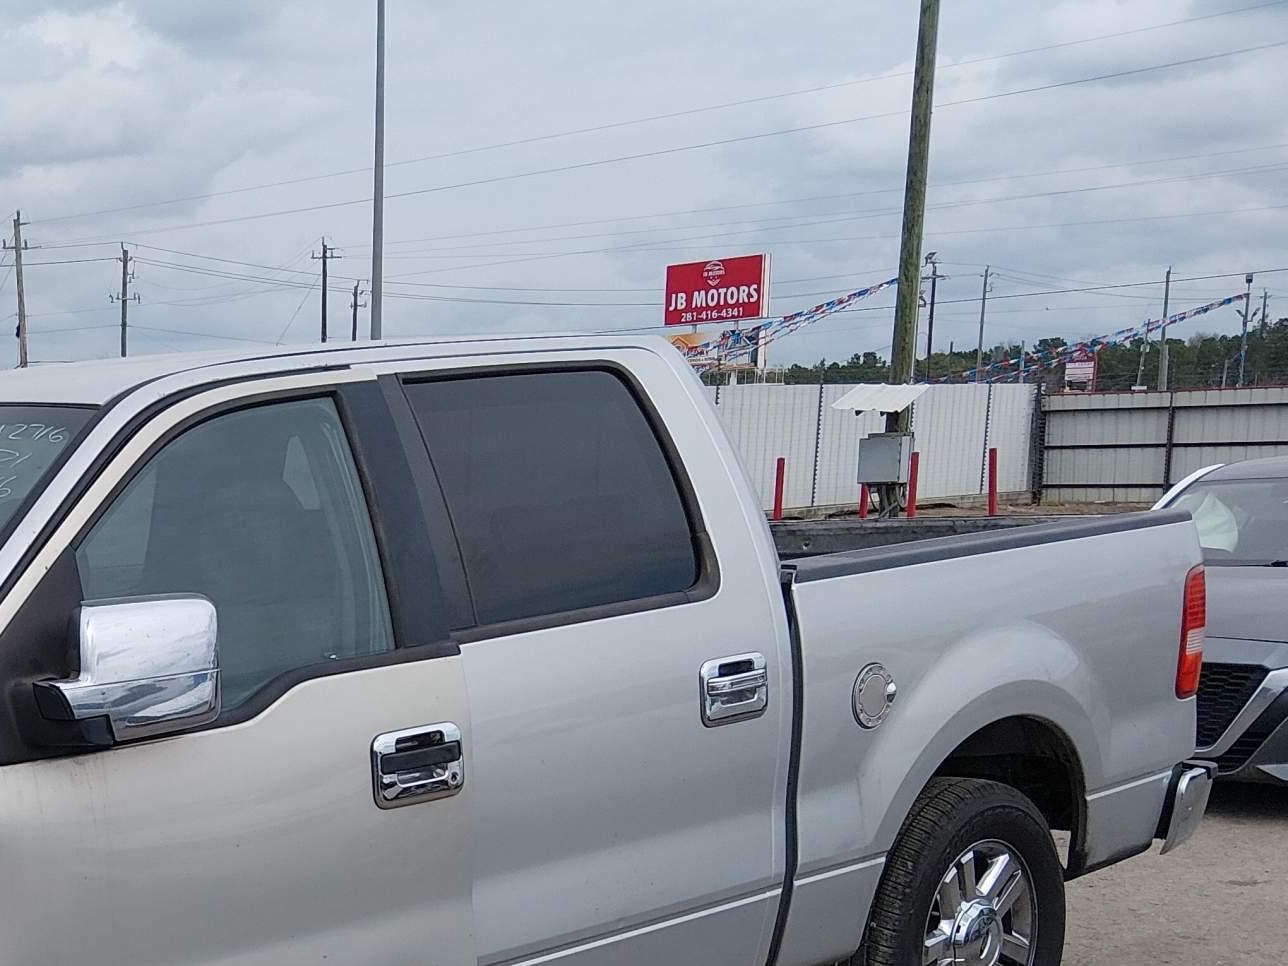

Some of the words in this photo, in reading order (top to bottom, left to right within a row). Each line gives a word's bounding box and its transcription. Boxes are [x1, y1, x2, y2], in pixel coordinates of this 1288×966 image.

[669, 292, 686, 311] JB
[692, 284, 758, 307] MOTORS
[681, 308, 743, 321] 281-416-4341
